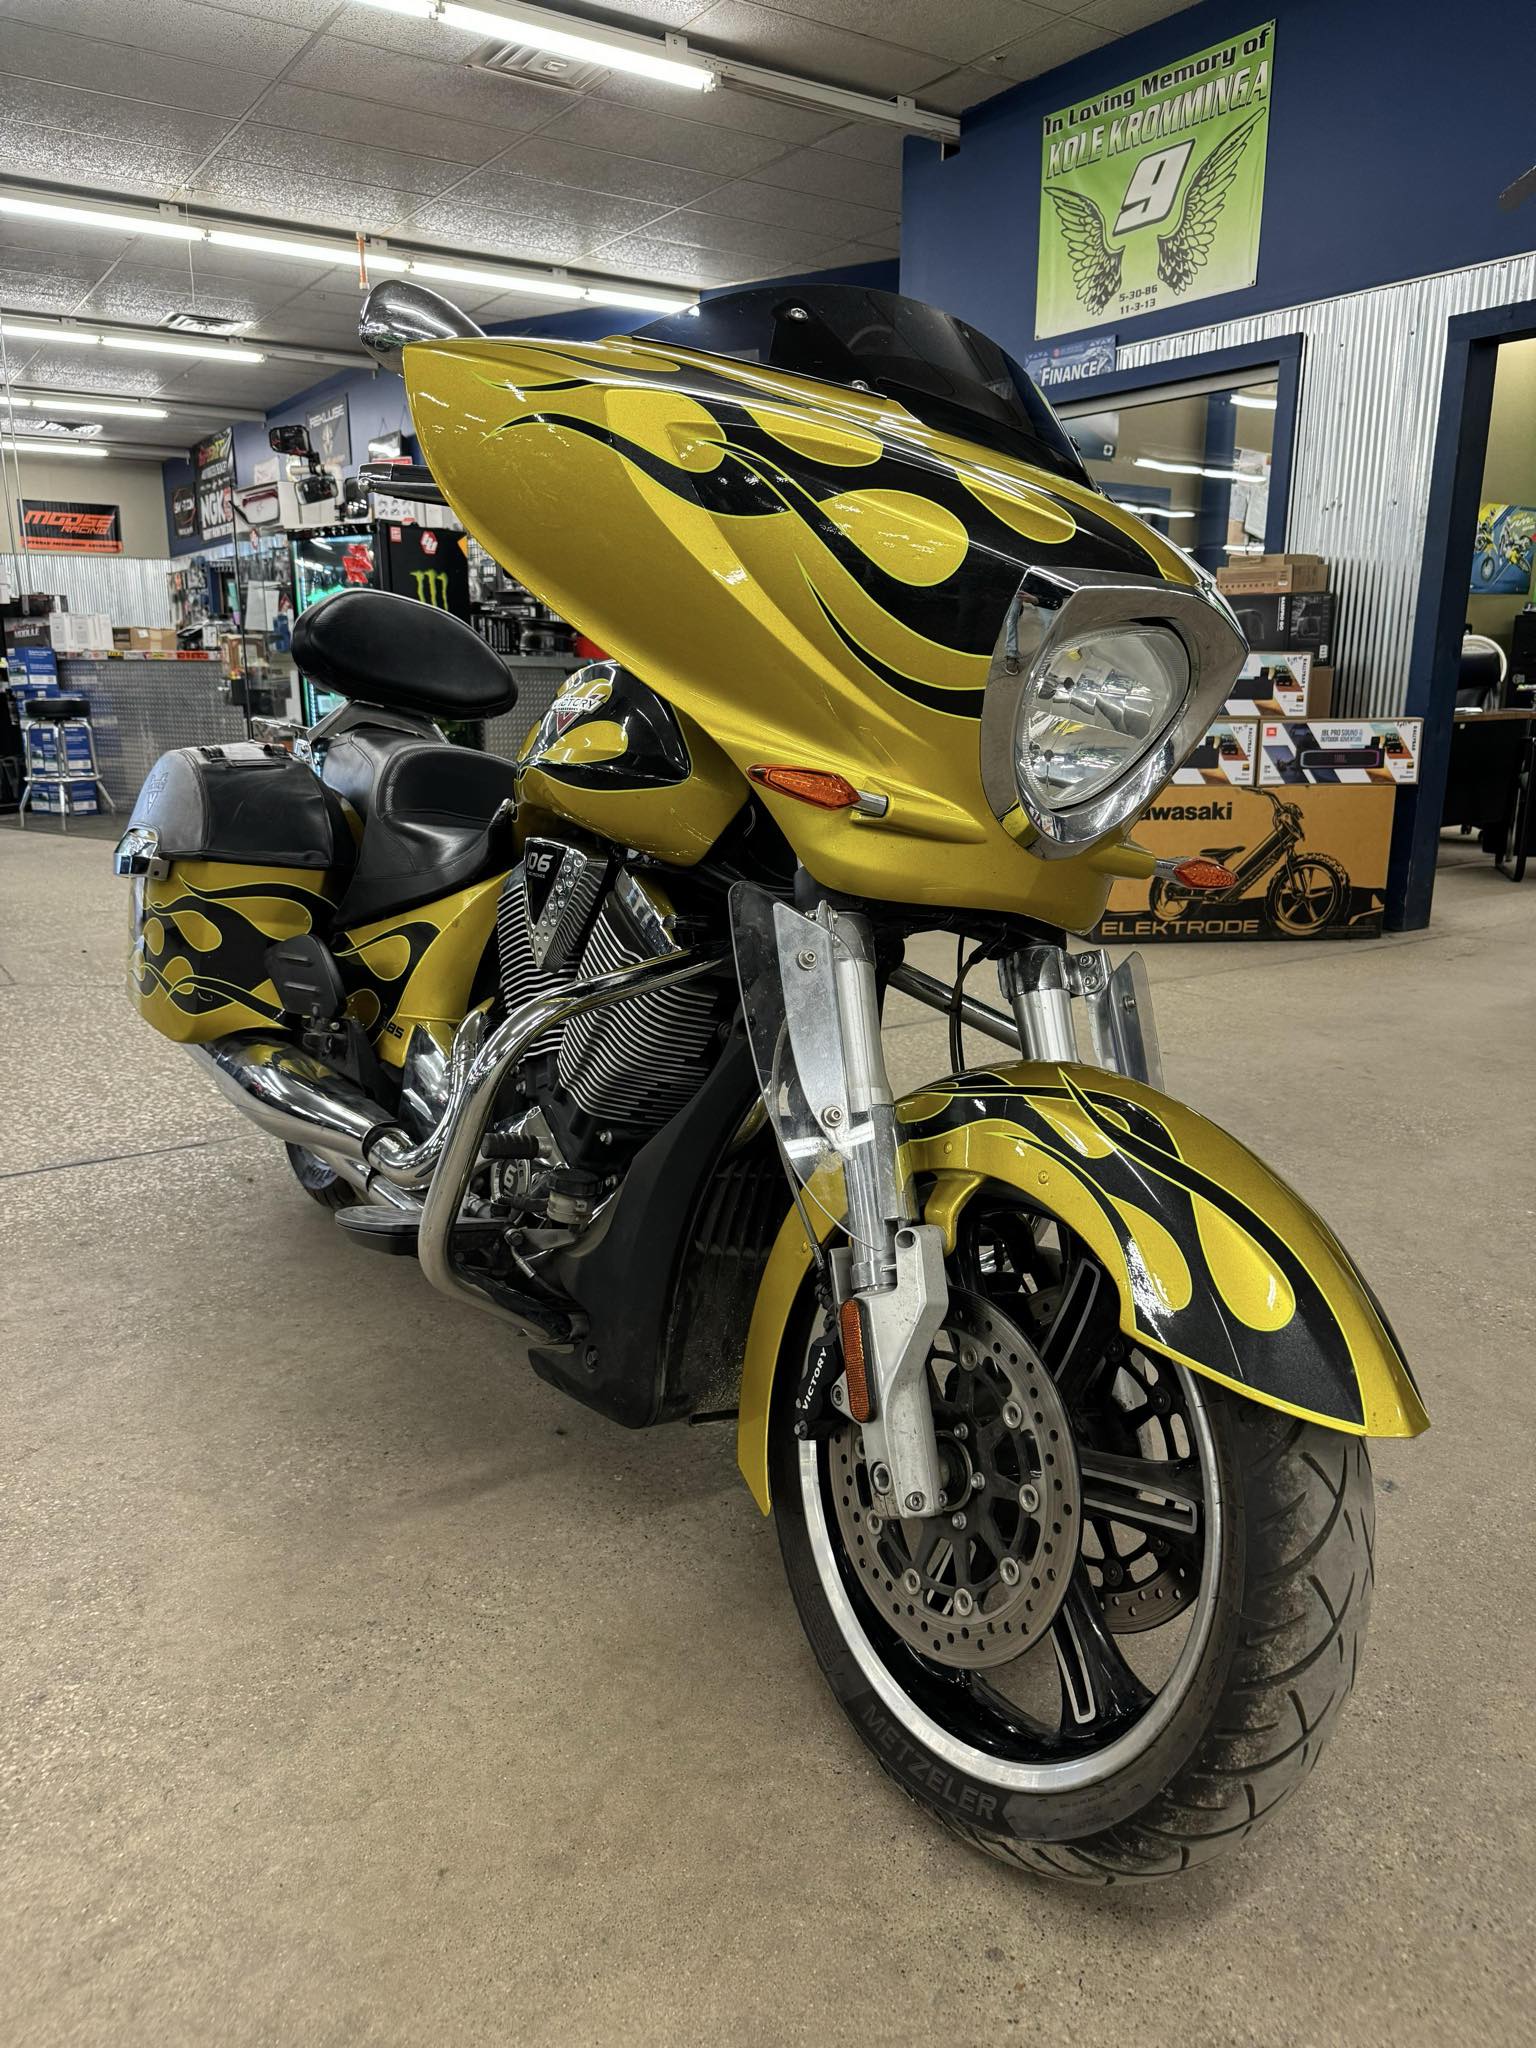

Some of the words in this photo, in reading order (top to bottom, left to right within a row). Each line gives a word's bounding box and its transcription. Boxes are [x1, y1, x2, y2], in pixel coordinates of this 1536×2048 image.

[1045, 117, 1064, 136] In
[1068, 87, 1137, 127] Loving
[1141, 46, 1237, 98] Memory
[1243, 27, 1271, 56] of
[1046, 124, 1105, 180] KOLE
[1106, 60, 1269, 158] KROMMINGA
[1113, 138, 1197, 237] 9
[1119, 284, 1158, 302] 5-30-86
[1120, 298, 1156, 315] 11-3-13
[1041, 360, 1098, 387] FINANCE
[24, 510, 115, 528] MOOSE
[200, 489, 225, 528] NGK
[61, 525, 107, 535] RACING
[1140, 801, 1234, 821] awasaki
[1101, 919, 1260, 936] ELEKTRODE
[802, 1346, 827, 1410] VICTORY
[861, 1704, 999, 1820] METZELER
